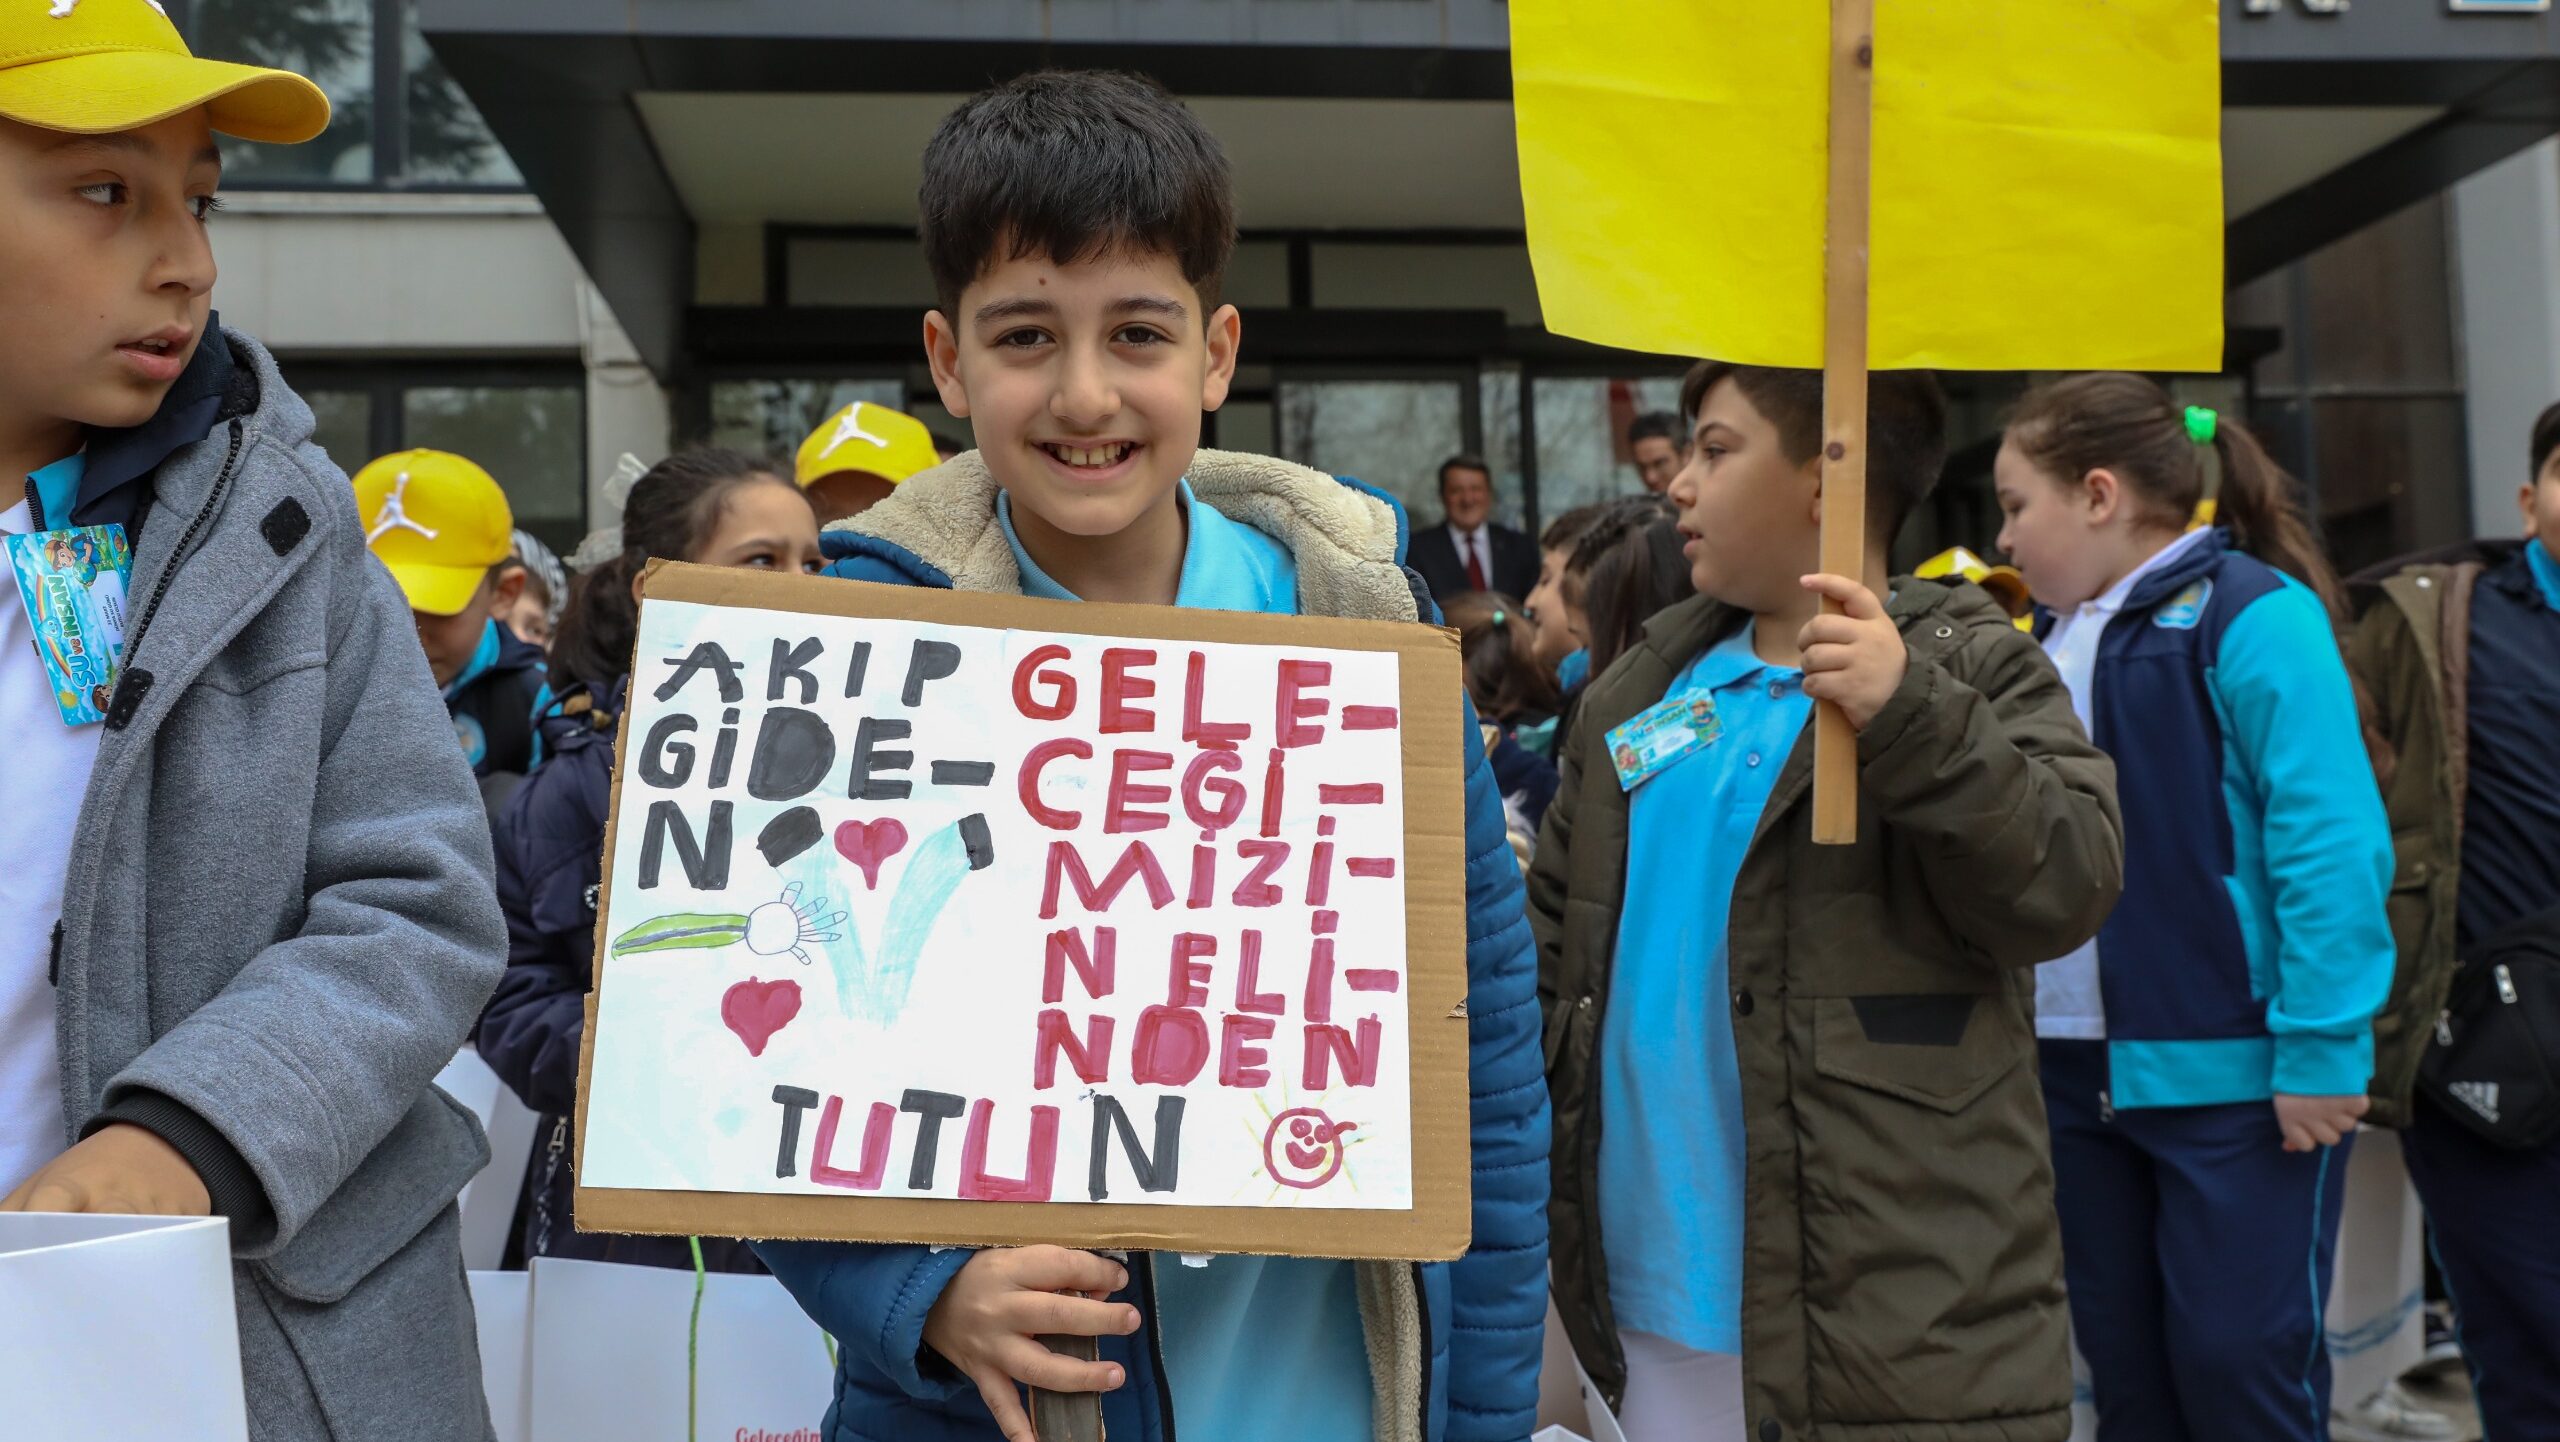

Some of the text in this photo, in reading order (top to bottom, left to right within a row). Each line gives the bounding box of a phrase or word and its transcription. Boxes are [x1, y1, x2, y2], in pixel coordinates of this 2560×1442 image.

[48, 576, 96, 688] SU ve İNSAN
[654, 638, 962, 707] AKIP
[1012, 644, 1399, 749] GELE-
[638, 707, 995, 801] GİDE-
[1018, 738, 1384, 838] CEĞİ-
[638, 800, 733, 890] N
[1039, 815, 1395, 919] MİZİ-
[1033, 1005, 1382, 1091] NDEN
[772, 1084, 1186, 1202] TUTUN
